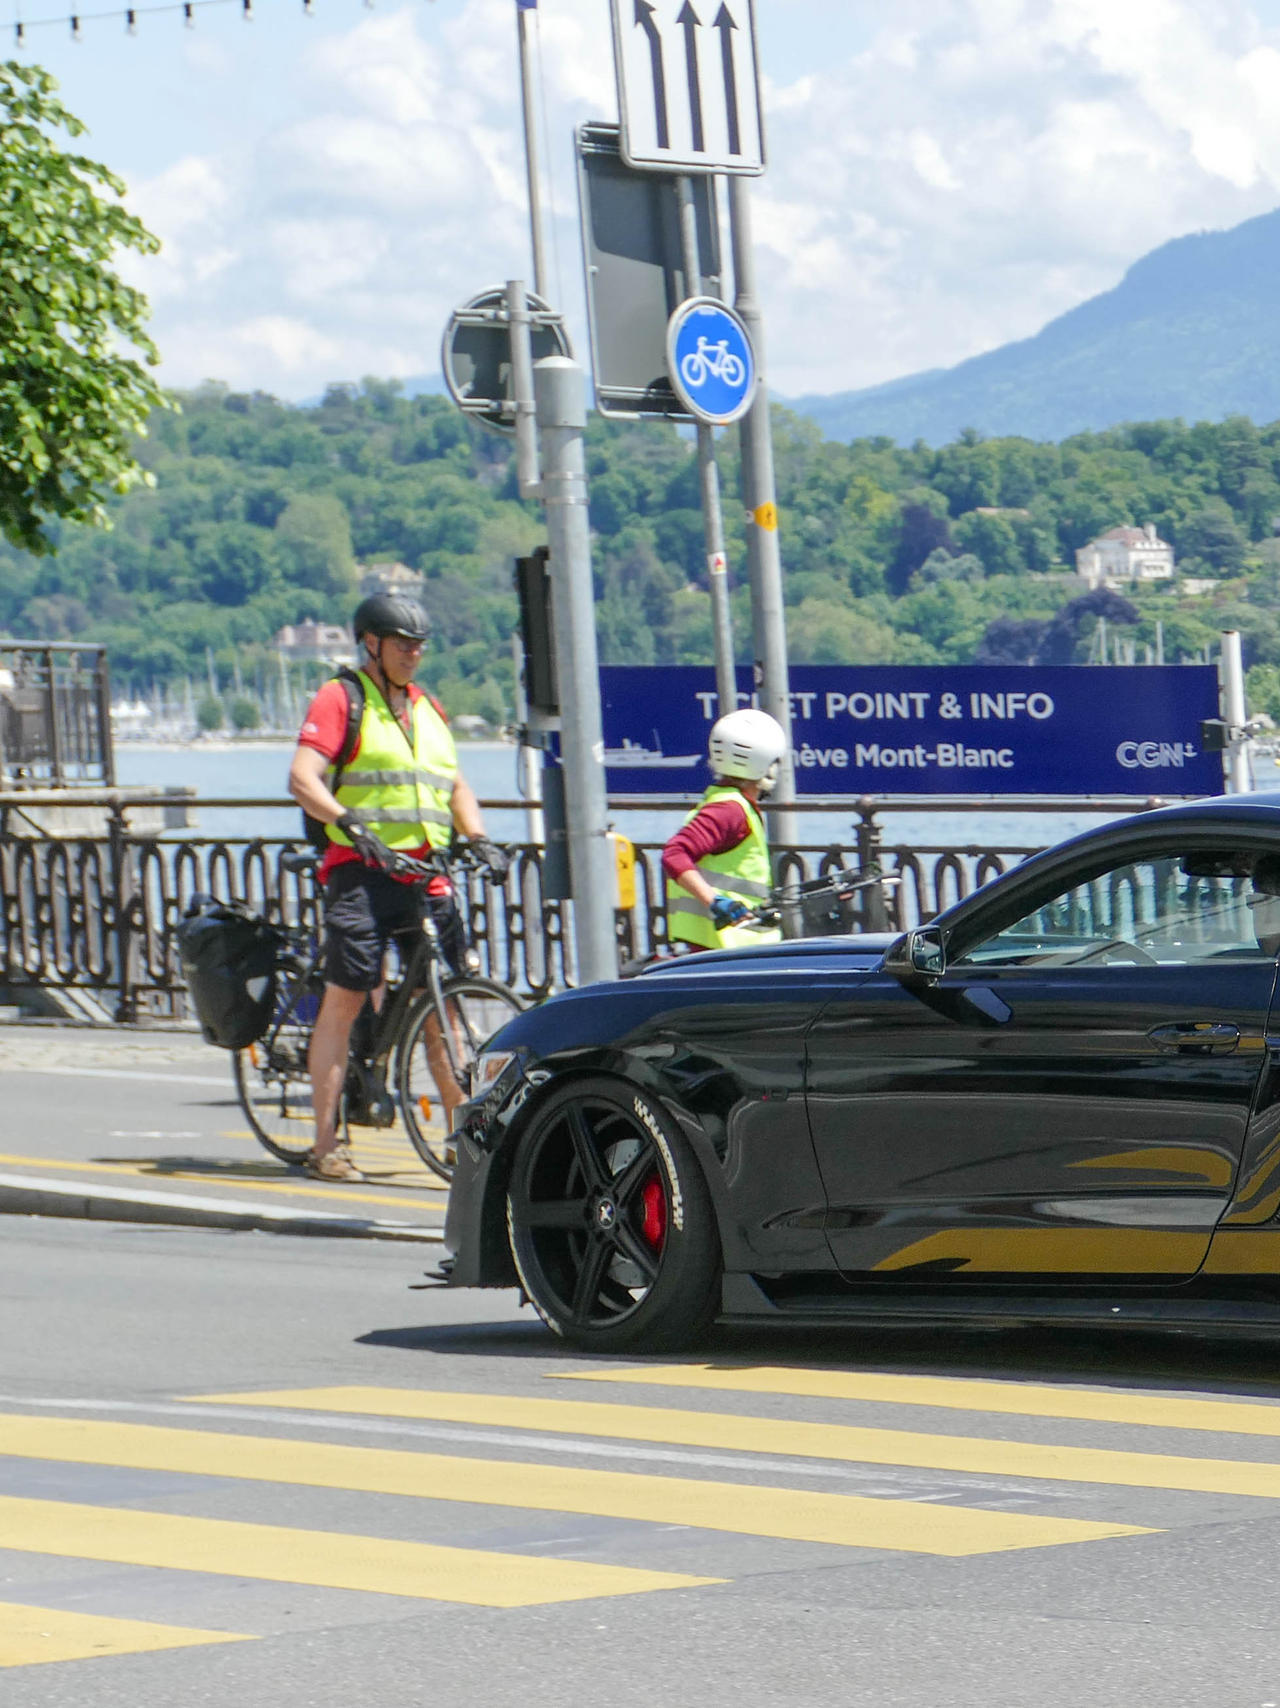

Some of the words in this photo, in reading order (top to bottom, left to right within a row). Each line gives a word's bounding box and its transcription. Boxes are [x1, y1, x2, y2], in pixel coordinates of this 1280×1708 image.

[826, 692, 932, 720] POINT
[939, 692, 964, 720] &
[972, 692, 1054, 720] INFO
[857, 743, 1014, 768] Mont-Blanc
[1116, 741, 1184, 768] CGN
